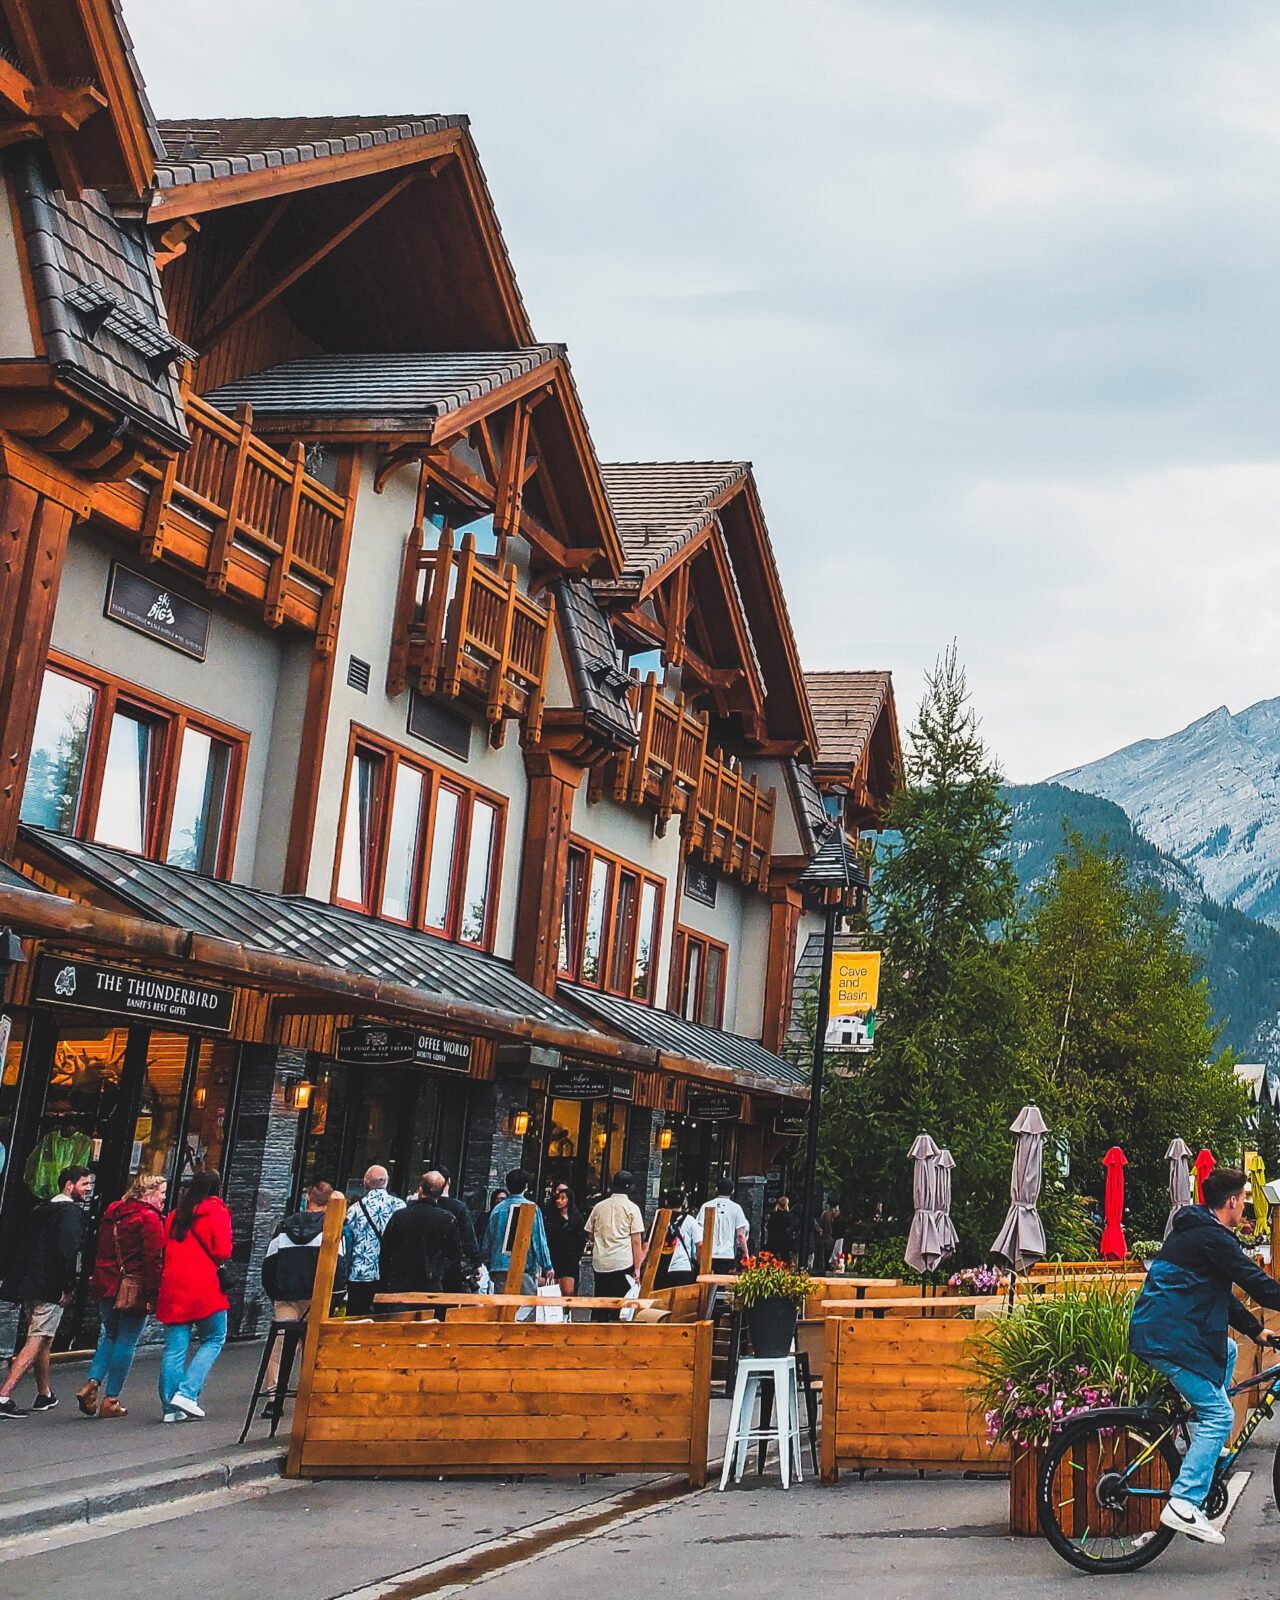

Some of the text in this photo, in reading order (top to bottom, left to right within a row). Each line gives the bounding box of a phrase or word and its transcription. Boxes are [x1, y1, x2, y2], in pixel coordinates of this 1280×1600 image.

[839, 965, 868, 977] Cave
[838, 977, 860, 988] and
[96, 972, 218, 1009] THE THUNDERBIRD
[838, 990, 868, 1001] Basin
[126, 997, 187, 1016] BANFF'S BEST GIFTS
[418, 1035, 470, 1057] OFFEE WORLD
